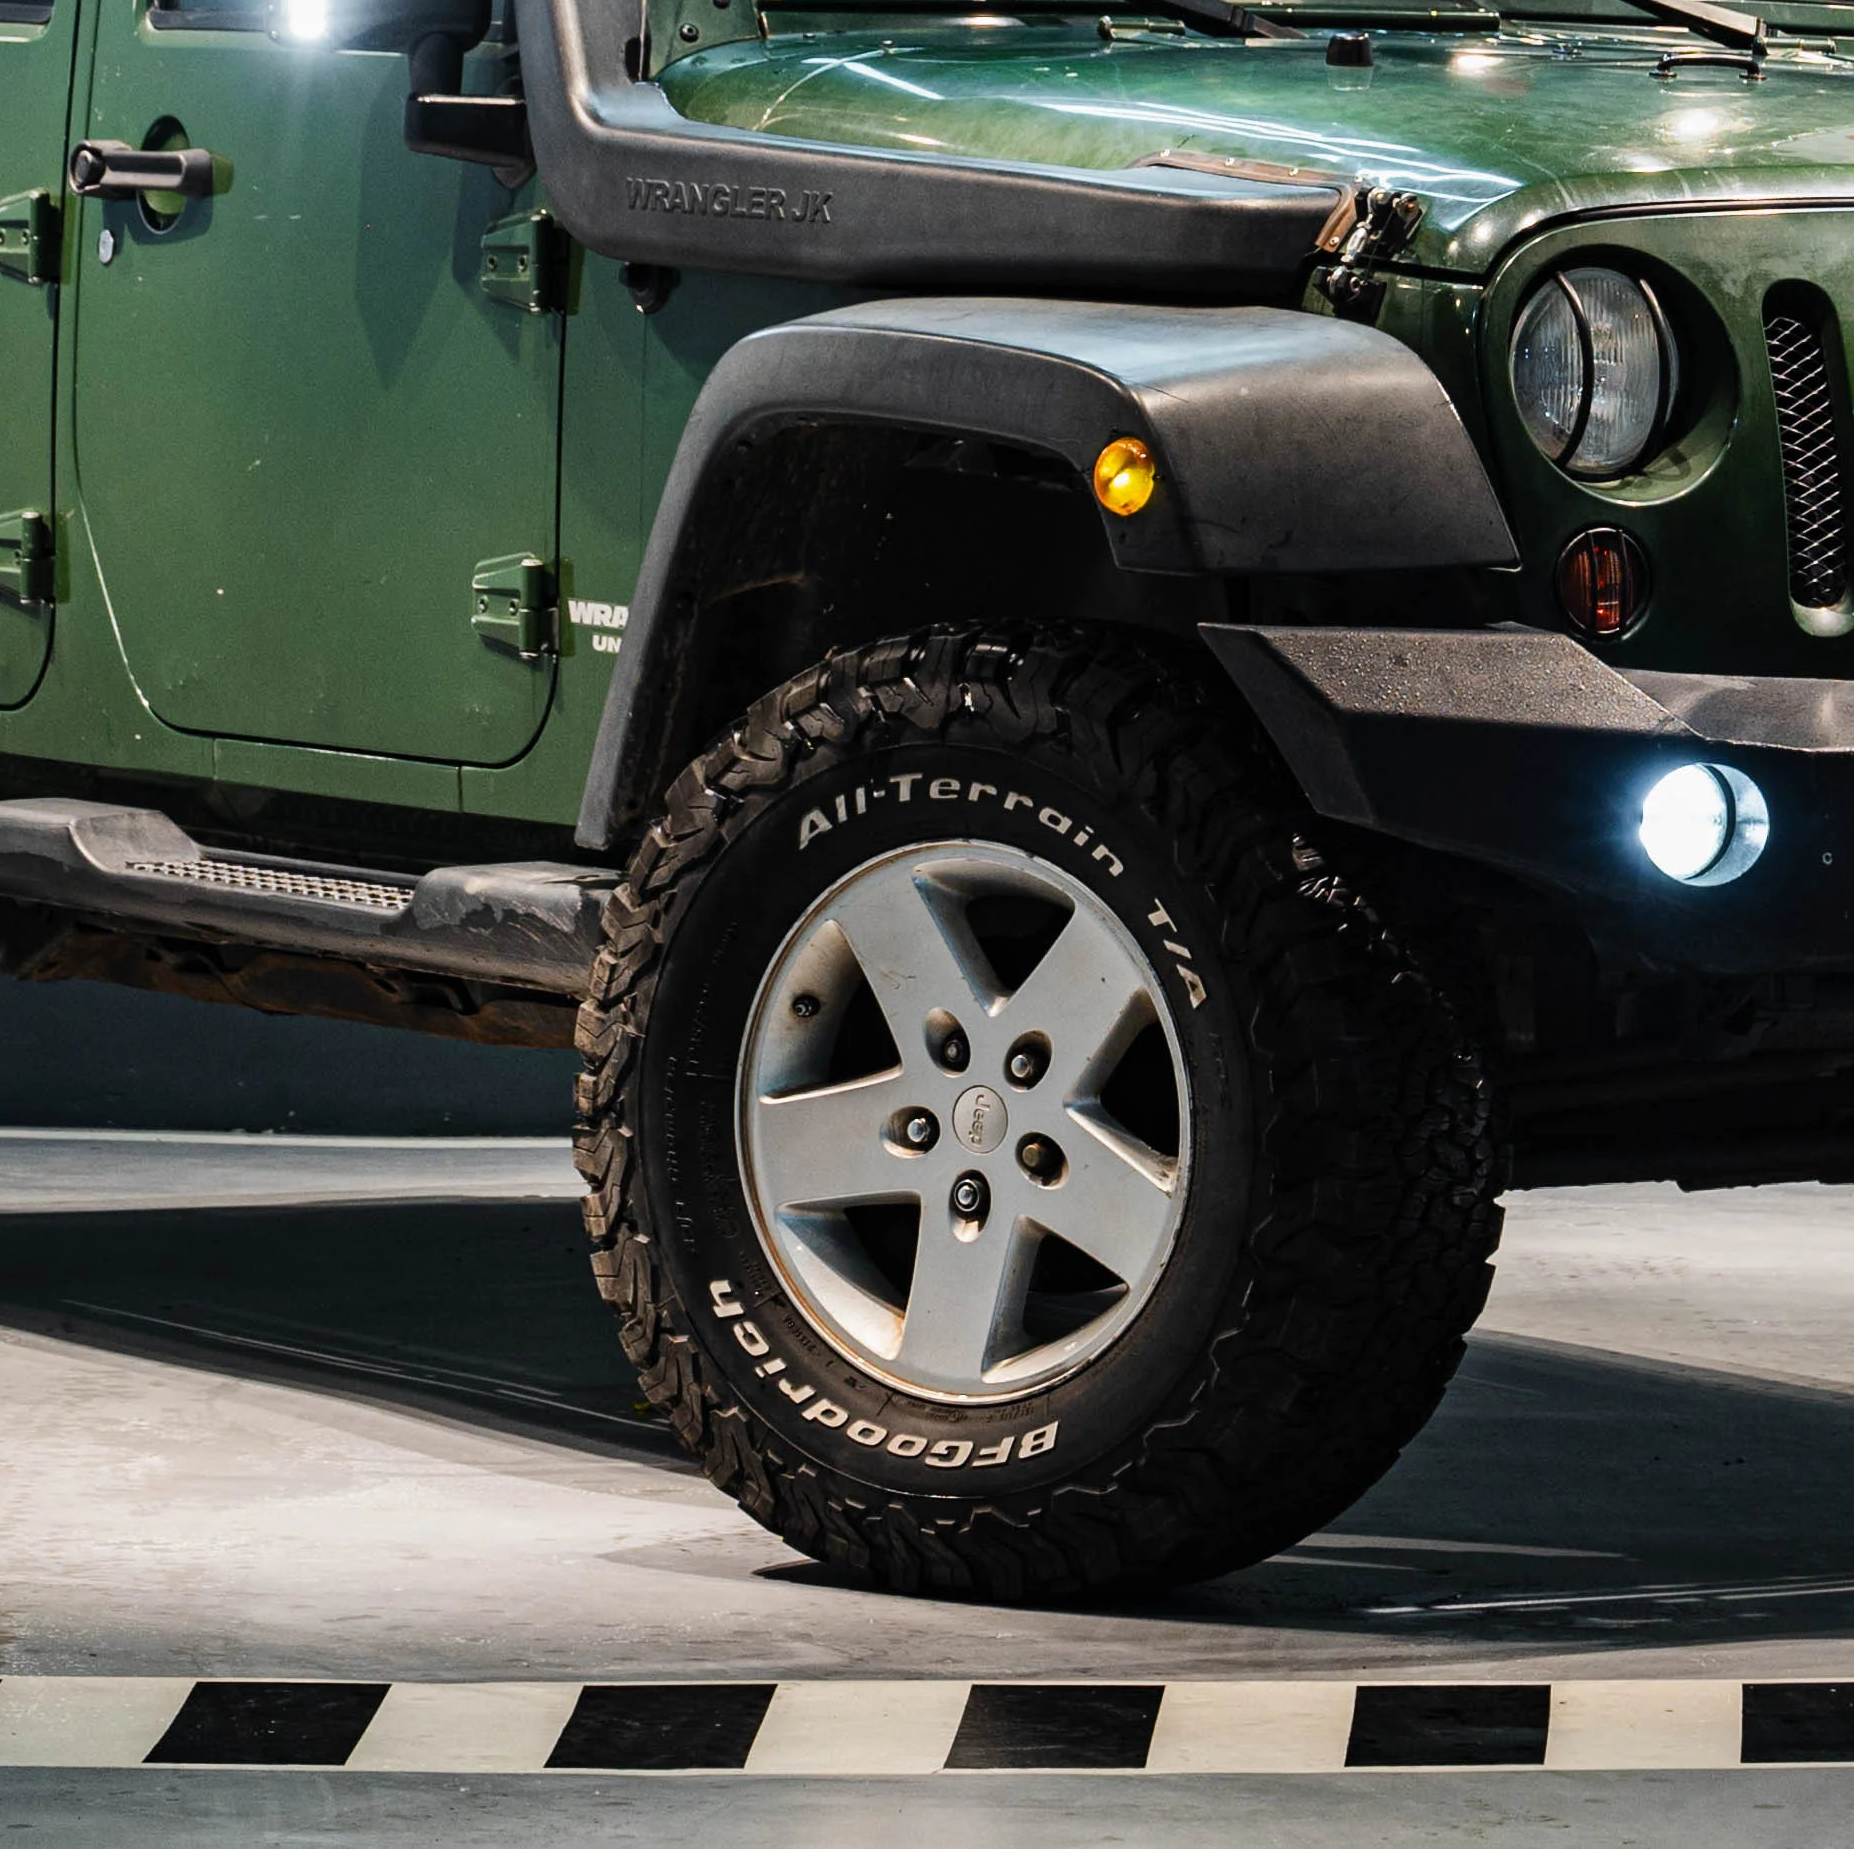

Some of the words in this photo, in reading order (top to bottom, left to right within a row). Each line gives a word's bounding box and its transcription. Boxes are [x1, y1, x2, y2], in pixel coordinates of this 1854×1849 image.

[625, 176, 787, 222] WRANGLER
[791, 190, 834, 224] JK
[799, 773, 1124, 877] All-Terrain
[1147, 898, 1207, 1009] T/A
[709, 1279, 1059, 1468] BFGoodrich
